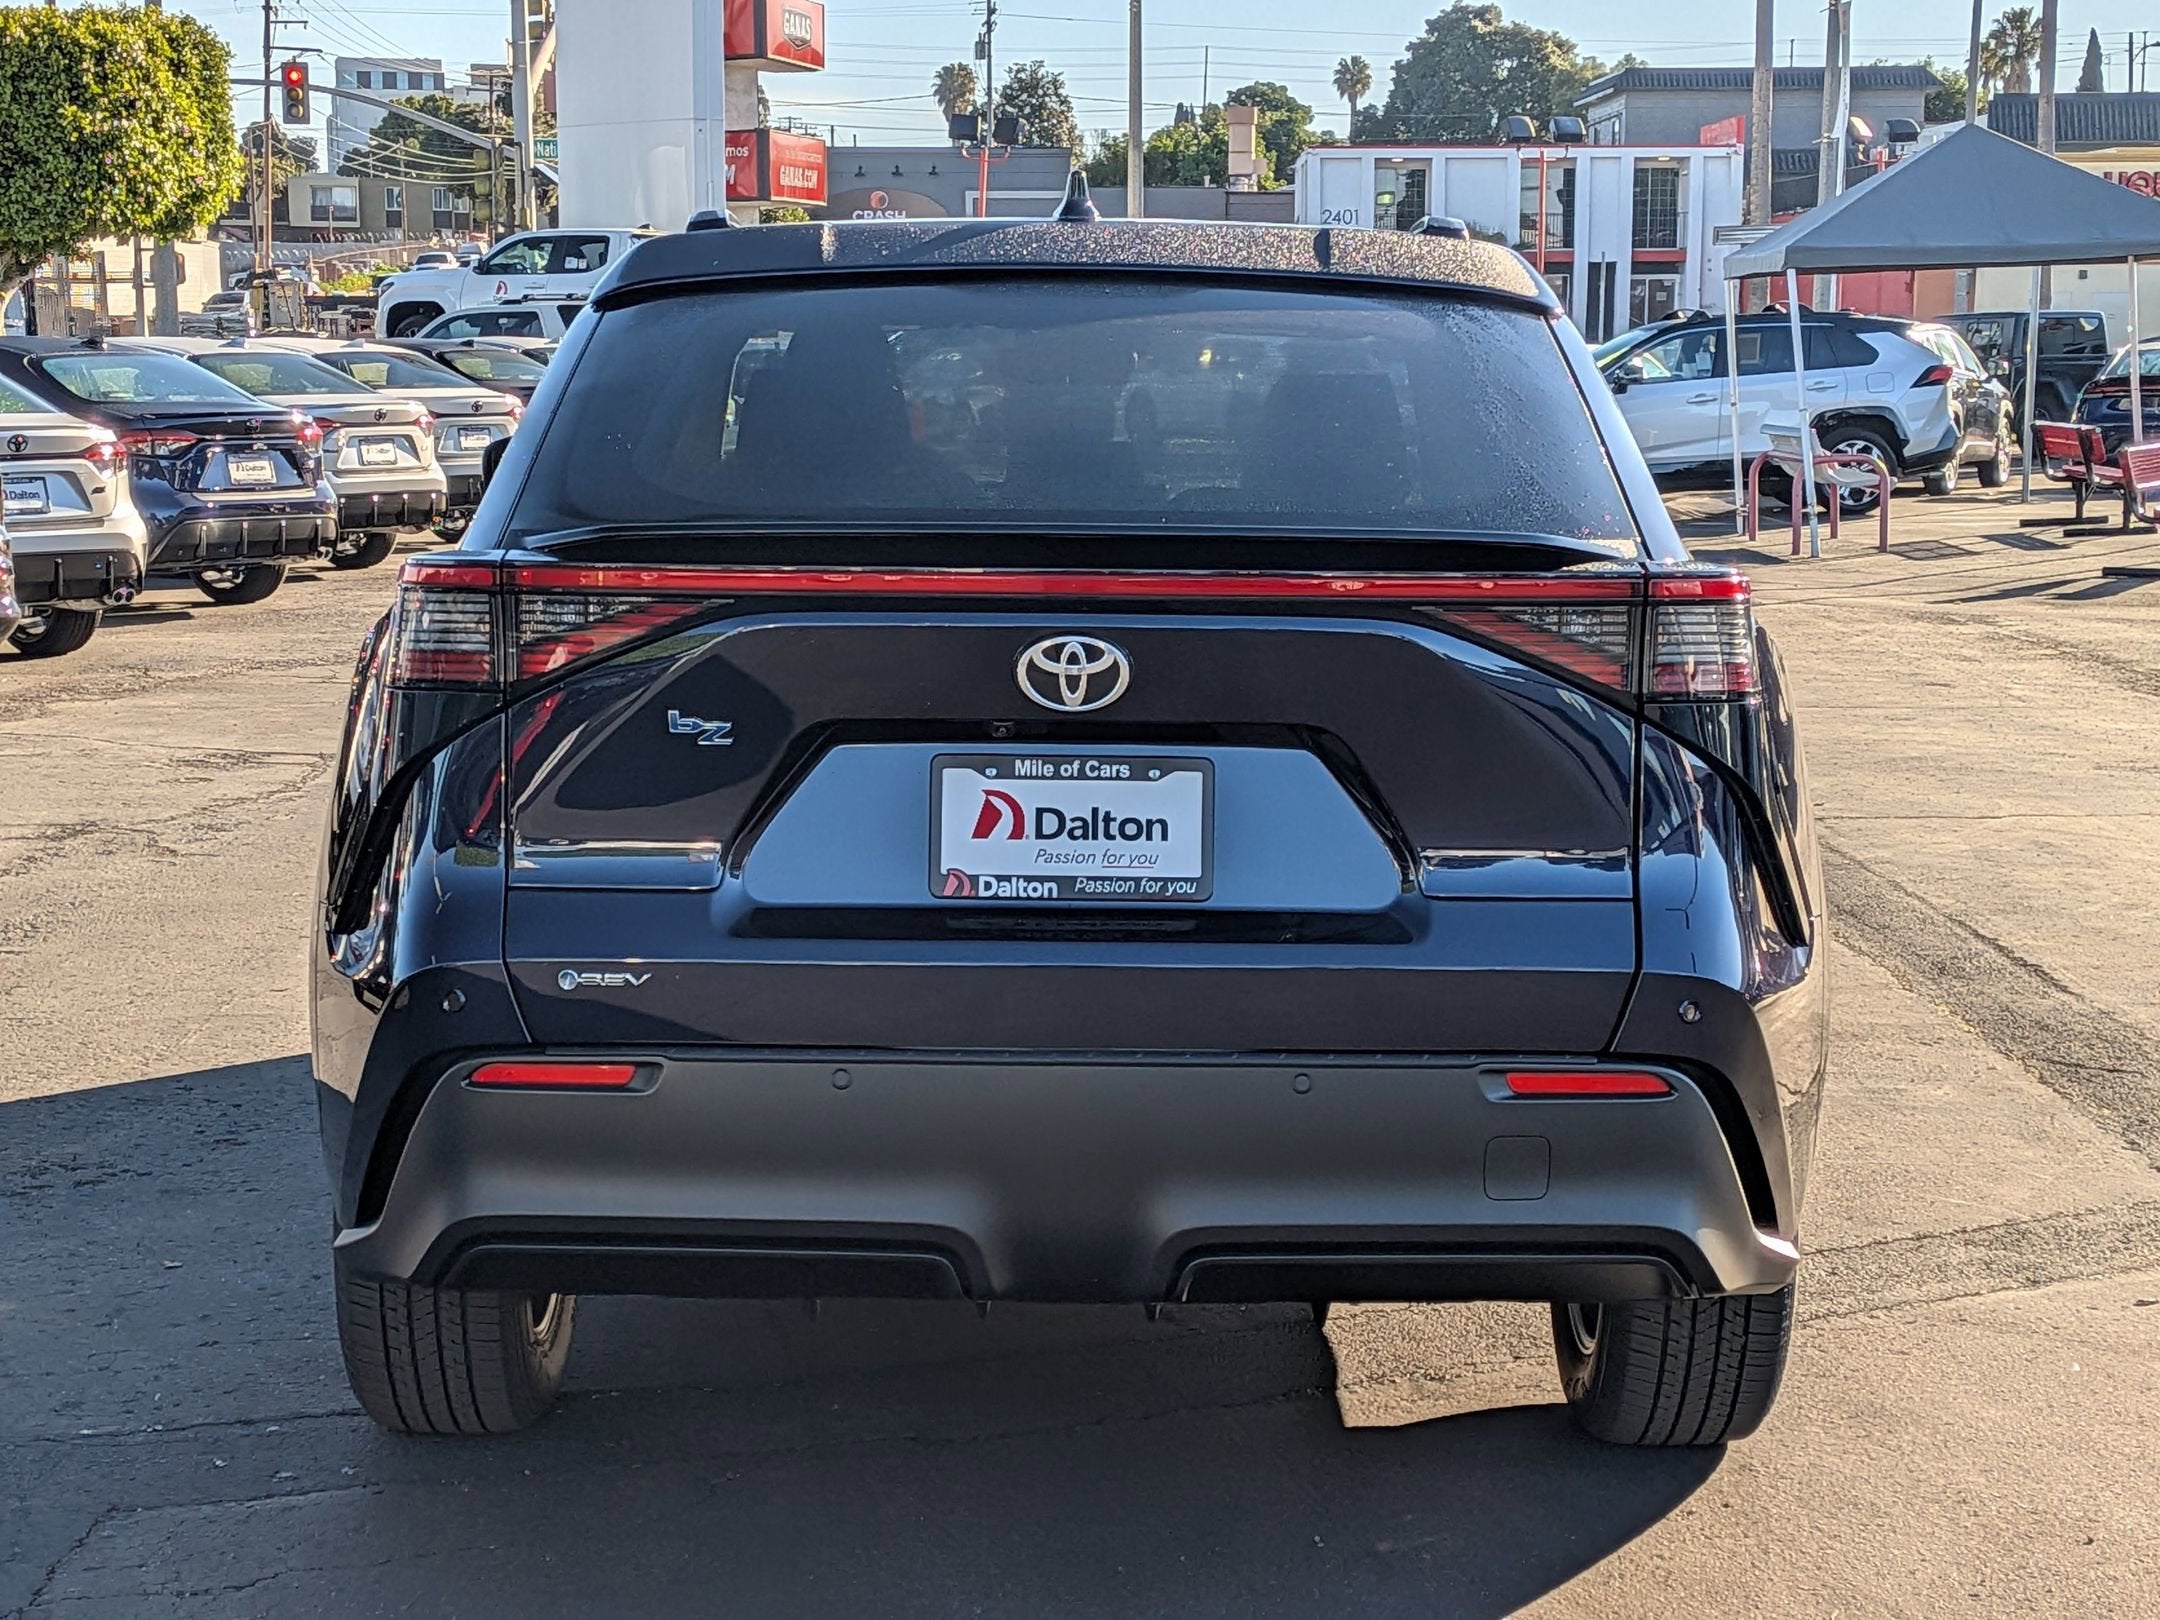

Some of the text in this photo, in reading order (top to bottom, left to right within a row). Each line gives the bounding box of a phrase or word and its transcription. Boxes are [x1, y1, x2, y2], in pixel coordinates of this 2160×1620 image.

[783, 11, 812, 41] GANAS
[536, 141, 558, 157] Nati
[725, 146, 749, 157] mos
[780, 165, 819, 190] GANAS.COM
[852, 210, 906, 220] CRASH
[1321, 209, 1359, 225] 2401
[1014, 759, 1131, 779] Mile of Cars
[1034, 806, 1169, 842] Dalton
[1034, 848, 1160, 867] Passion for you
[977, 875, 1198, 899] Dalton Passion for you
